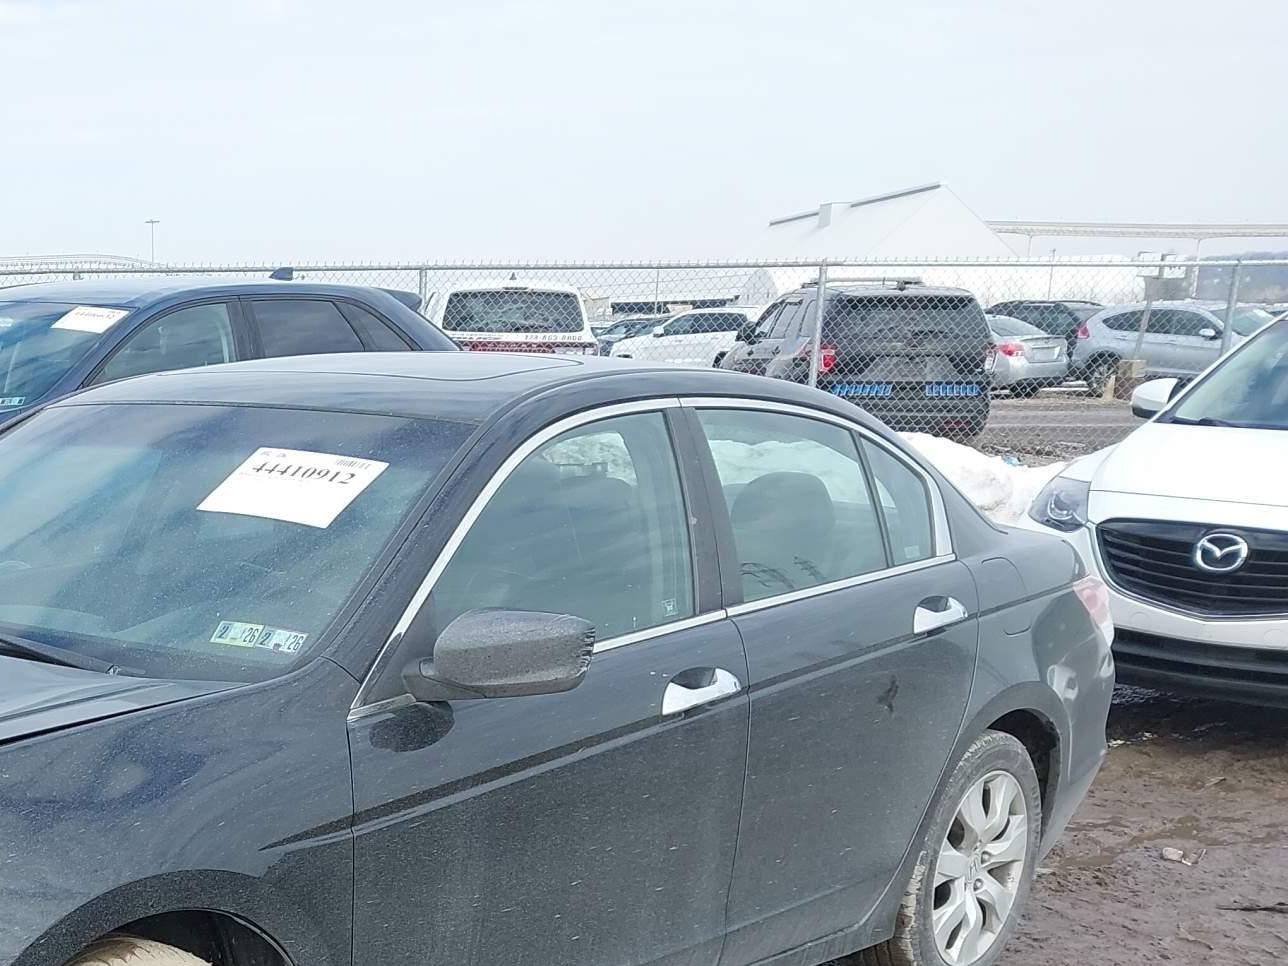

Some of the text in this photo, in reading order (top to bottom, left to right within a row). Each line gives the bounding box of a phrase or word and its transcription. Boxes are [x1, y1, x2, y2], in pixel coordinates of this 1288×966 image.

[252, 461, 357, 485] 44410912
[217, 625, 230, 639] 2
[258, 632, 272, 646] 2
